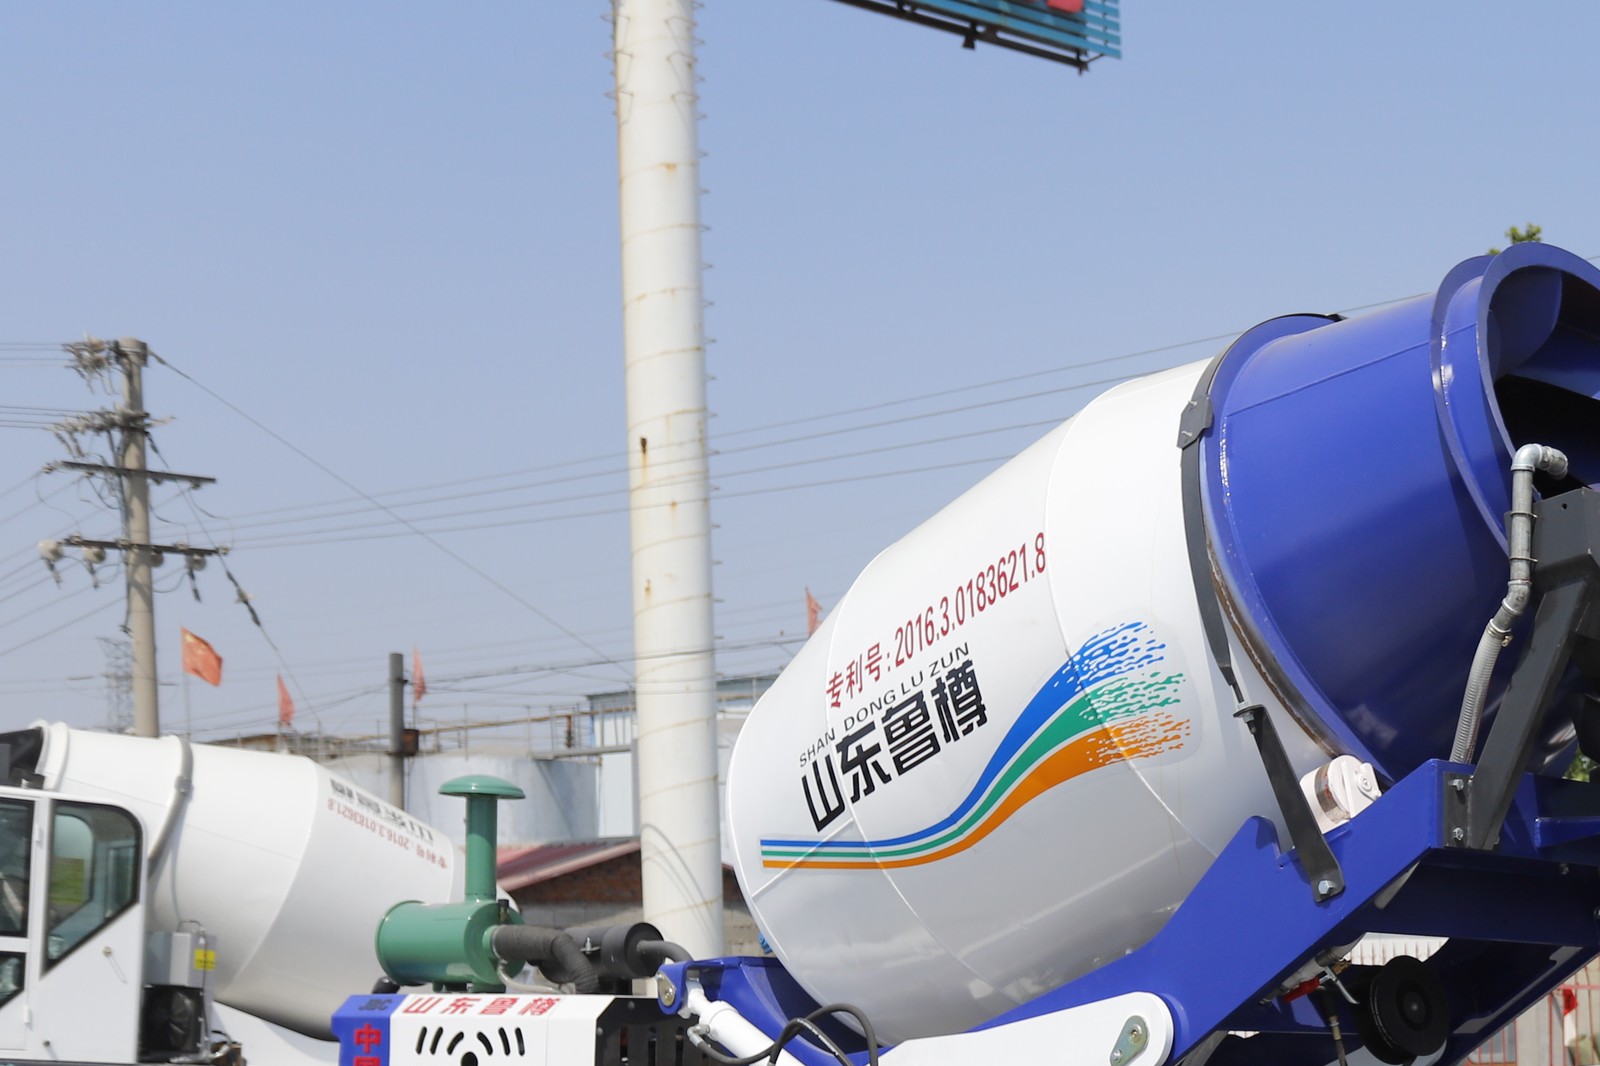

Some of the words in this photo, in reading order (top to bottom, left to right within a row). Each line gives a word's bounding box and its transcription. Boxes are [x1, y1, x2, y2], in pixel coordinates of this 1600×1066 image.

[800, 728, 835, 768] SHAN
[844, 689, 896, 731] DONG
[901, 671, 924, 695] LU
[929, 642, 969, 677] ZUN
[801, 659, 988, 833] 山东鲁樽
[403, 997, 561, 1016] 山东鲁樽
